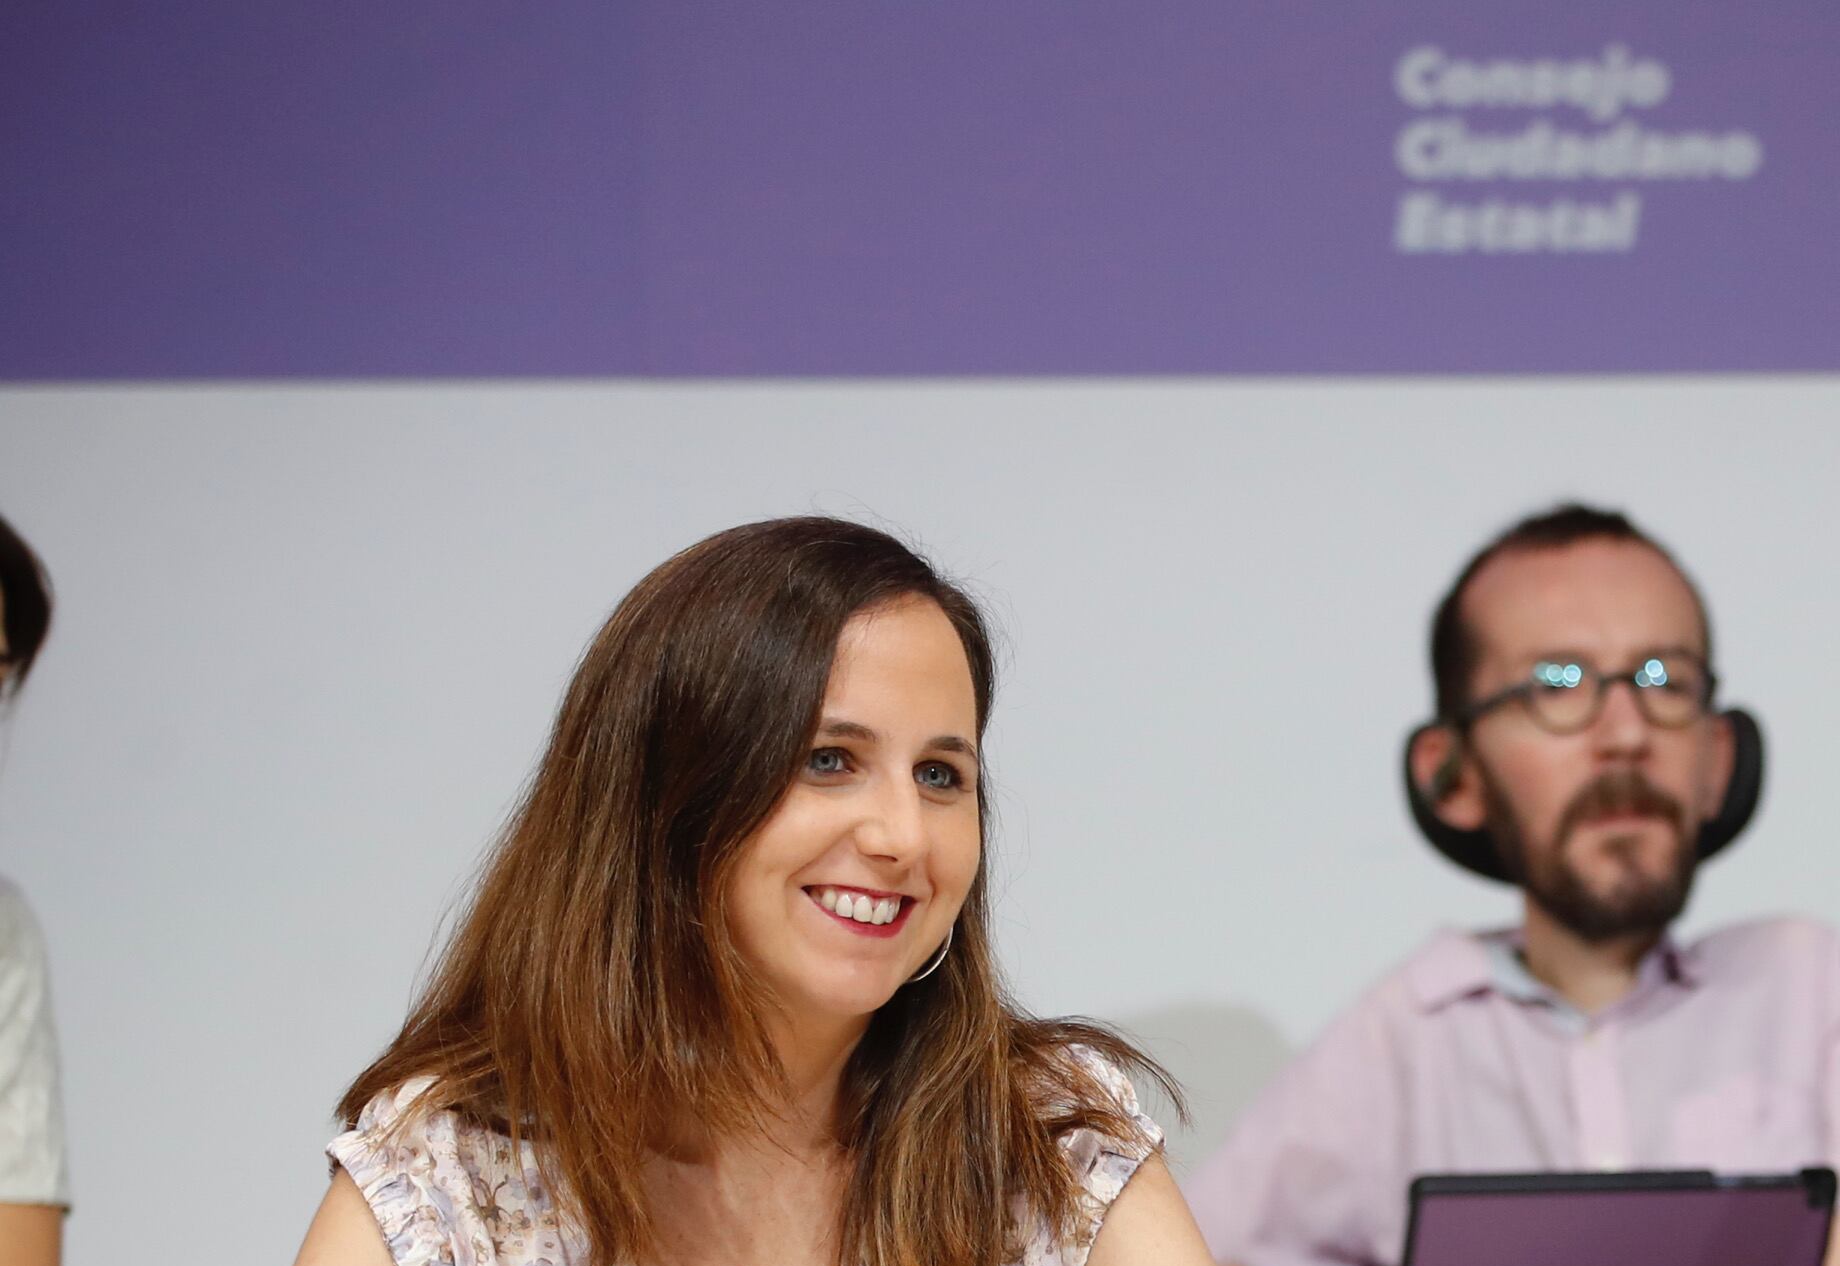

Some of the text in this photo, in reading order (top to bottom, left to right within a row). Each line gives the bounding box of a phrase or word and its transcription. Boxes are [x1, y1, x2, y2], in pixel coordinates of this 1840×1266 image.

[1396, 46, 1670, 122] Consejo
[1397, 119, 1761, 179] Ciudadano
[1397, 192, 1640, 253] Estatal
